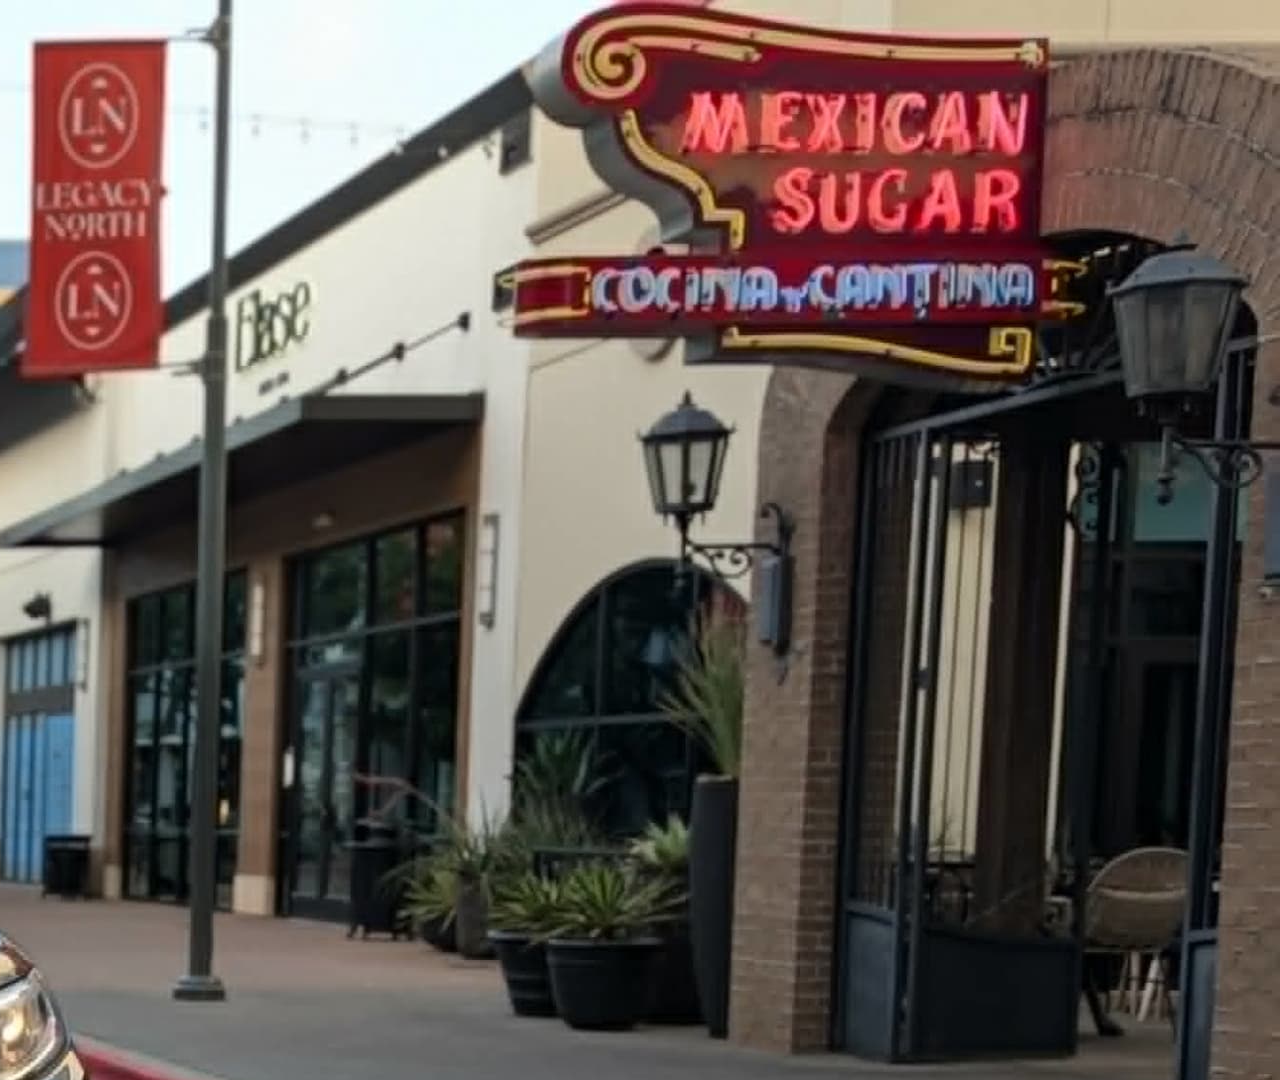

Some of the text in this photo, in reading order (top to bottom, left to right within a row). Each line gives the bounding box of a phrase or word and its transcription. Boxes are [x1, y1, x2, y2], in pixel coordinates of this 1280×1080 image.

[70, 97, 128, 137] LN
[681, 90, 1028, 156] MEXICAN
[37, 179, 151, 210] LEGACY
[772, 167, 1022, 234] SUGAR
[45, 210, 146, 240] NORTH
[67, 282, 121, 321] LN
[591, 265, 778, 314] COCINA
[808, 262, 1036, 316] CANTINA
